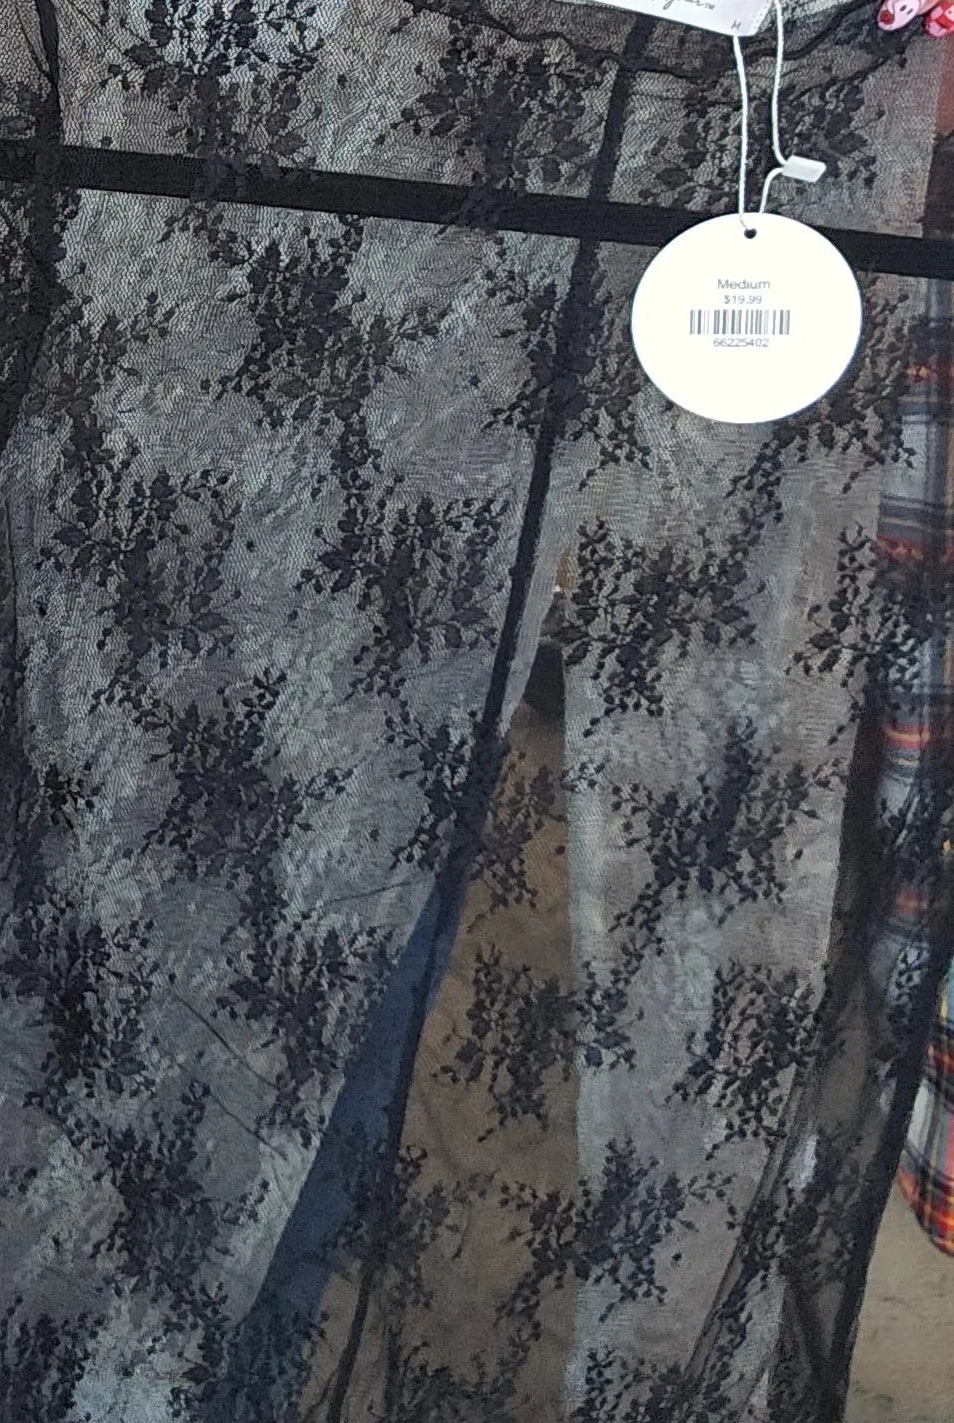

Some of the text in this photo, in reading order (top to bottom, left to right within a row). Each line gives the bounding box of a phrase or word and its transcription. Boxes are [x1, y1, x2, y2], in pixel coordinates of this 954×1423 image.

[717, 278, 771, 290] Medium
[723, 294, 763, 305] $19.99
[712, 337, 770, 348] 66225402
